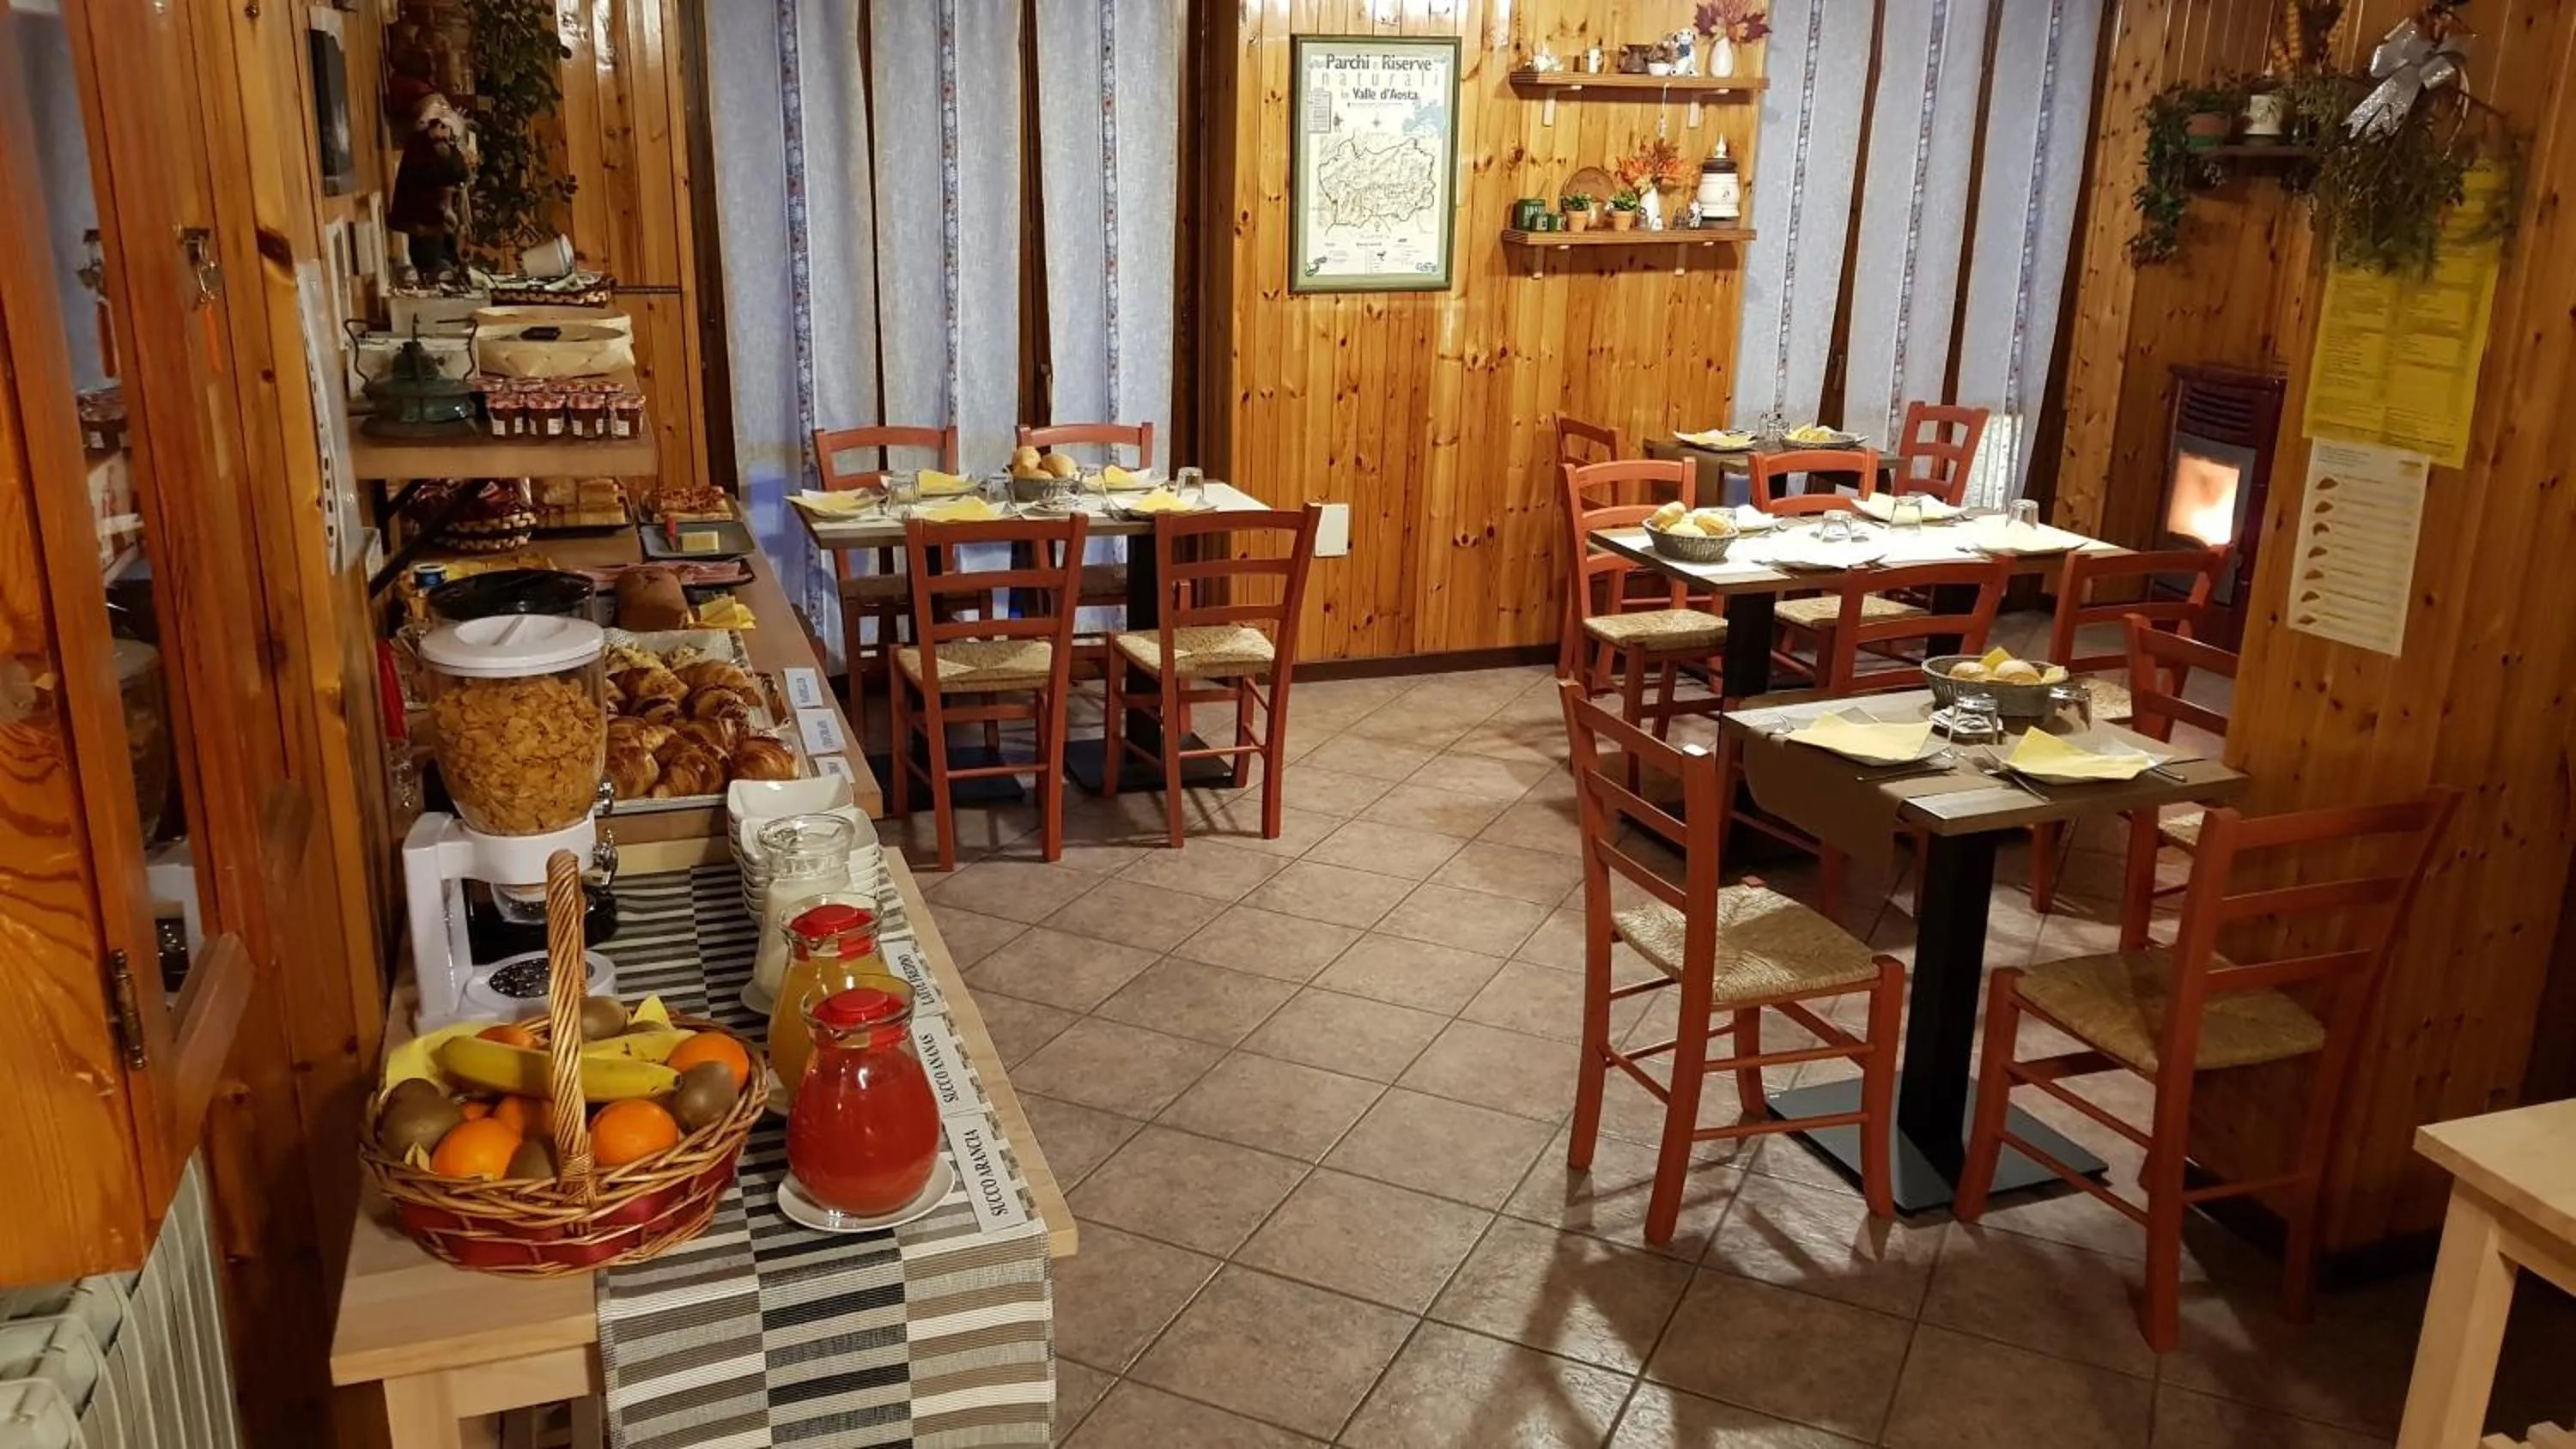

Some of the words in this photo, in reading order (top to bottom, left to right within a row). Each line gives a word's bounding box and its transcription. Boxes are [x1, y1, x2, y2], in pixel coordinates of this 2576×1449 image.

[1321, 70, 1438, 87] naturali
[1326, 54, 1370, 69] Parchi
[1382, 54, 1432, 70] Riserve
[1352, 88, 1376, 100] Valle
[1380, 88, 1419, 100] d'Aosta
[919, 1033, 943, 1070] ANANAS
[934, 1070, 959, 1103] SUCCO
[963, 1129, 993, 1177] ARANCIA
[981, 1179, 1008, 1216] SUCCO
